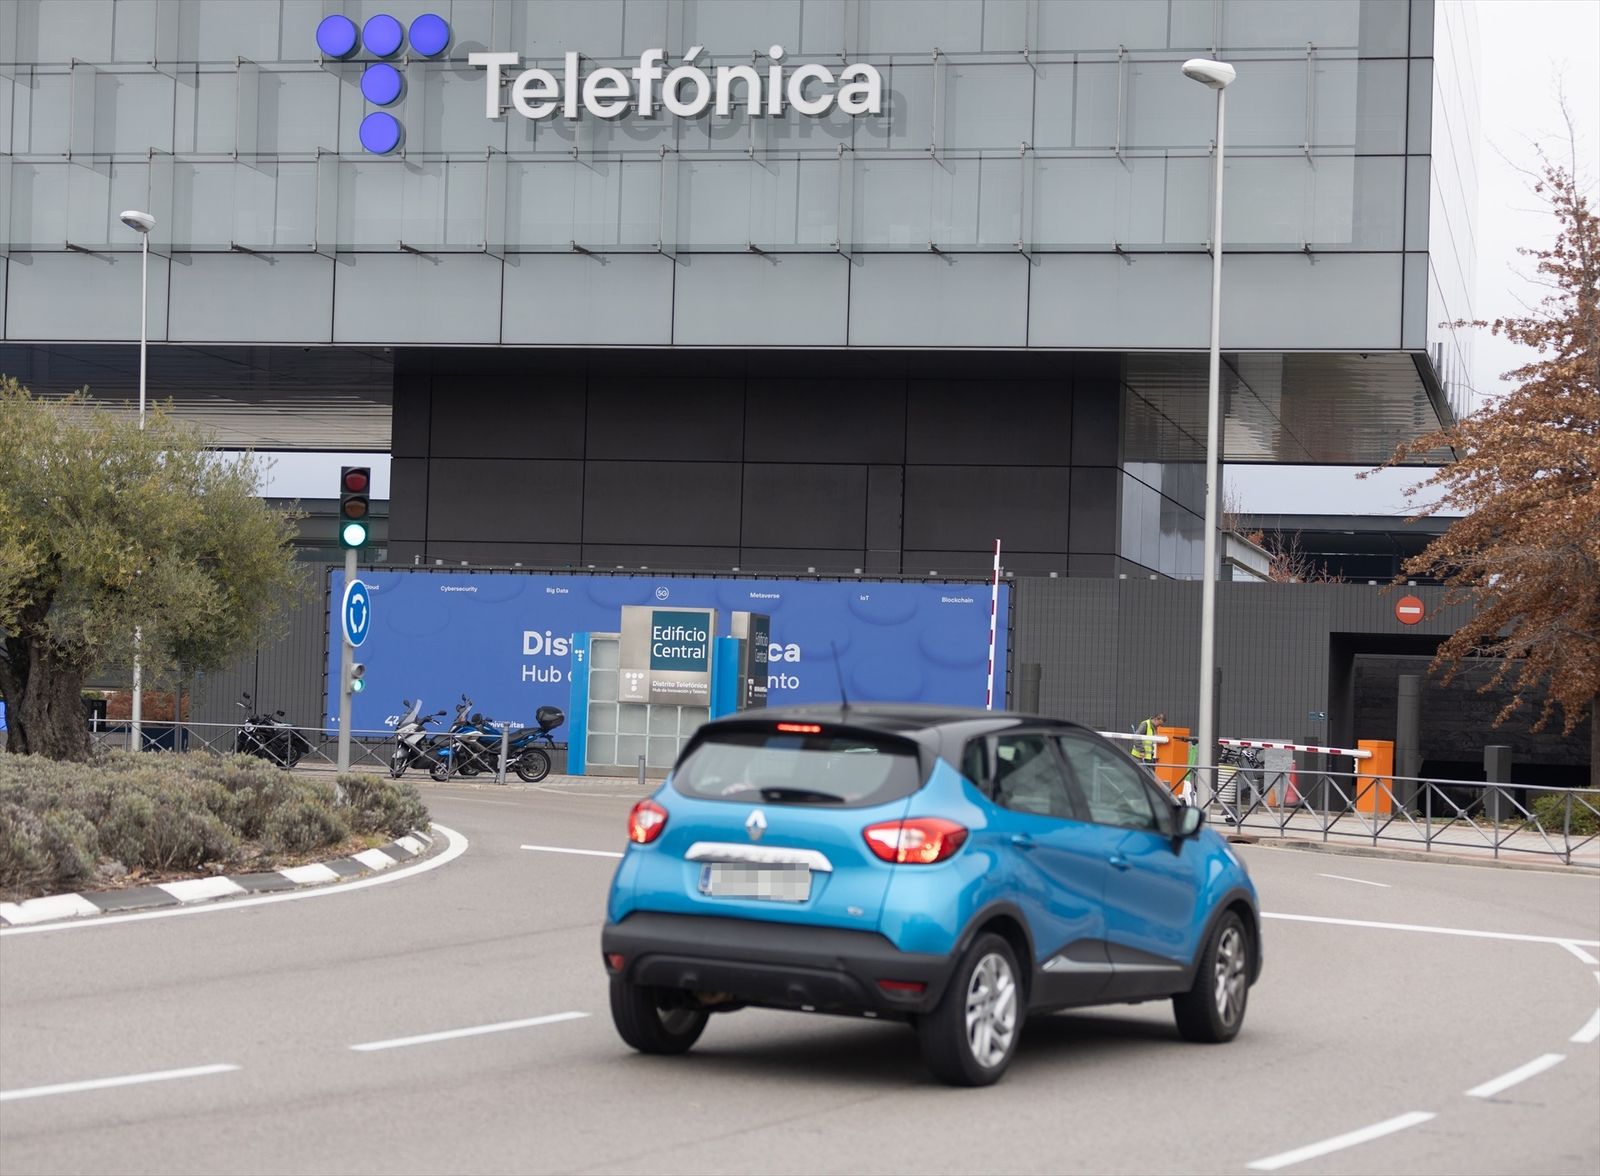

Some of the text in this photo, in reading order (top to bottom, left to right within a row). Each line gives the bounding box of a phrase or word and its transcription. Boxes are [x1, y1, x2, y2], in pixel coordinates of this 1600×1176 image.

[468, 45, 882, 120] Telefónica
[440, 585, 478, 593] Cybersecurity
[653, 625, 706, 642] Edificio
[523, 630, 573, 657] Dis
[653, 643, 706, 659] Central
[522, 664, 562, 683] Hub
[652, 680, 708, 689] Distrito Telefónica
